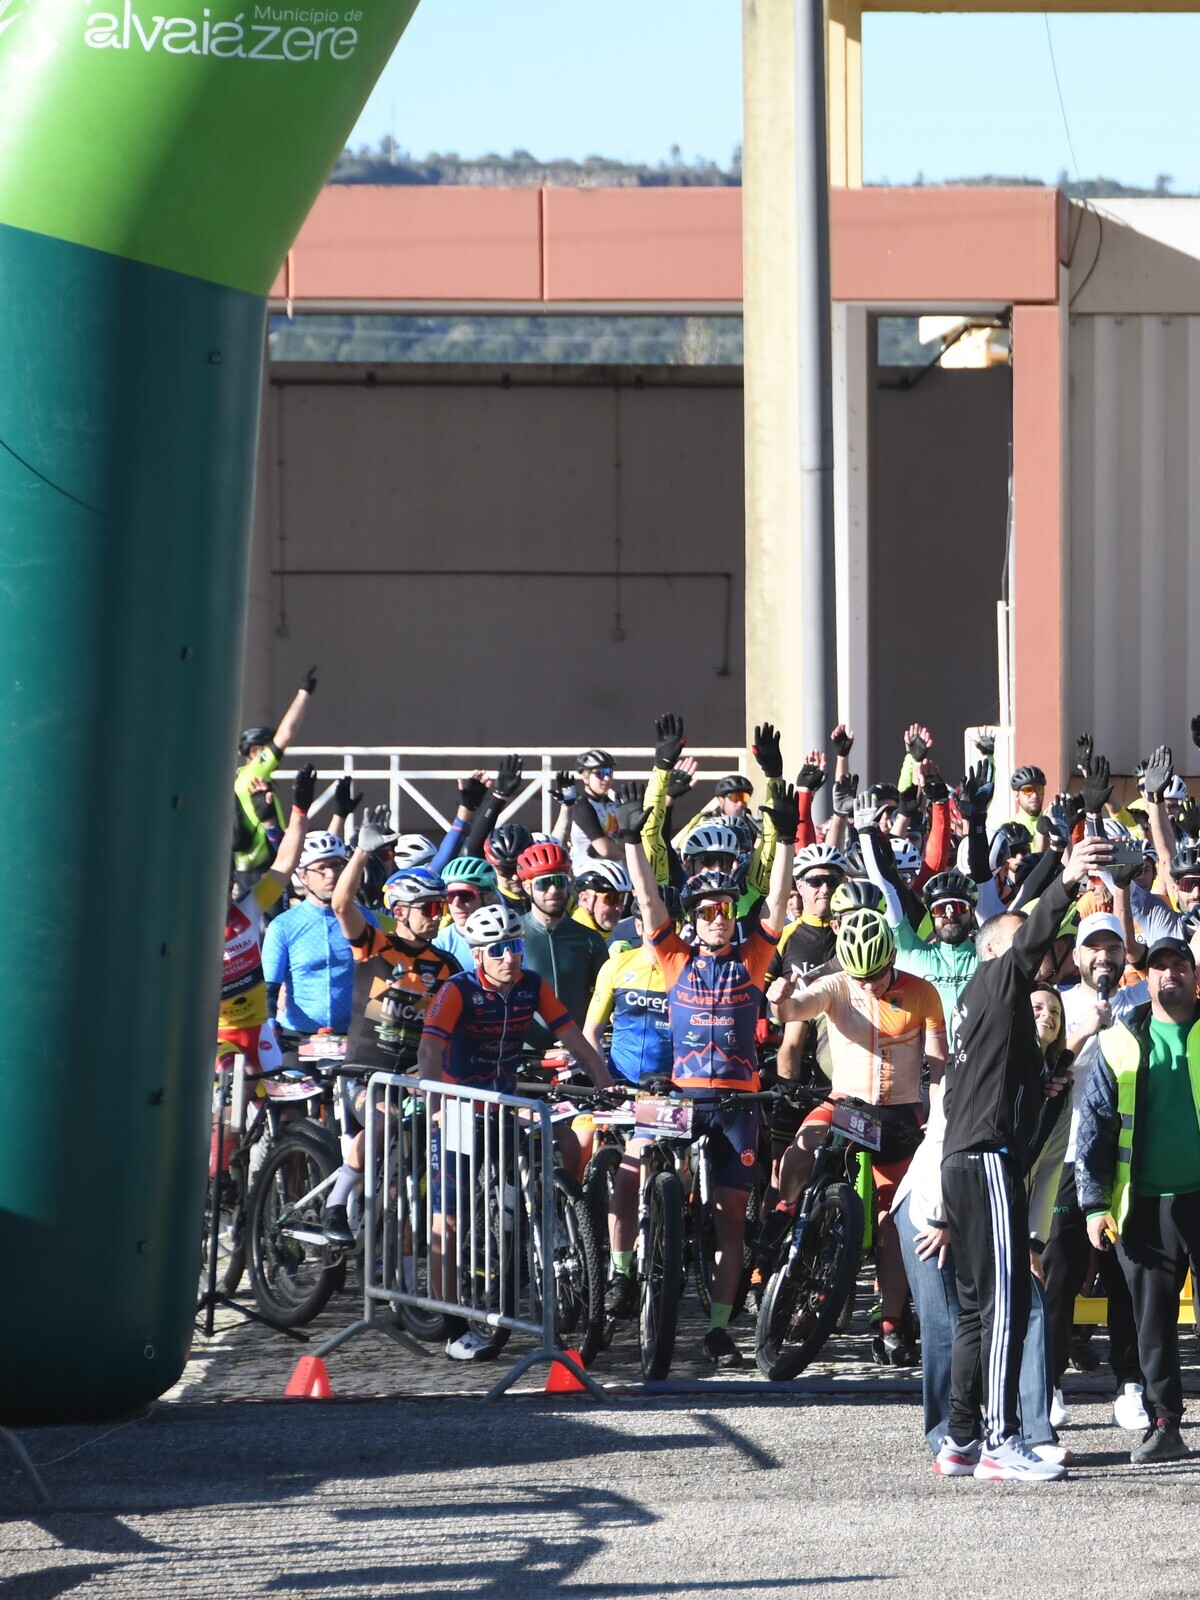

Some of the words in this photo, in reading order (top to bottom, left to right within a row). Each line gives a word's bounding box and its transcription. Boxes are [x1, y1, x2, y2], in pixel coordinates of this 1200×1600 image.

[254, 4, 339, 26] Município
[345, 9, 363, 22] de
[84, 0, 358, 62] alvaiázere
[923, 974, 974, 983] ORBE
[655, 1107, 673, 1122] 72
[849, 1115, 865, 1133] 98
